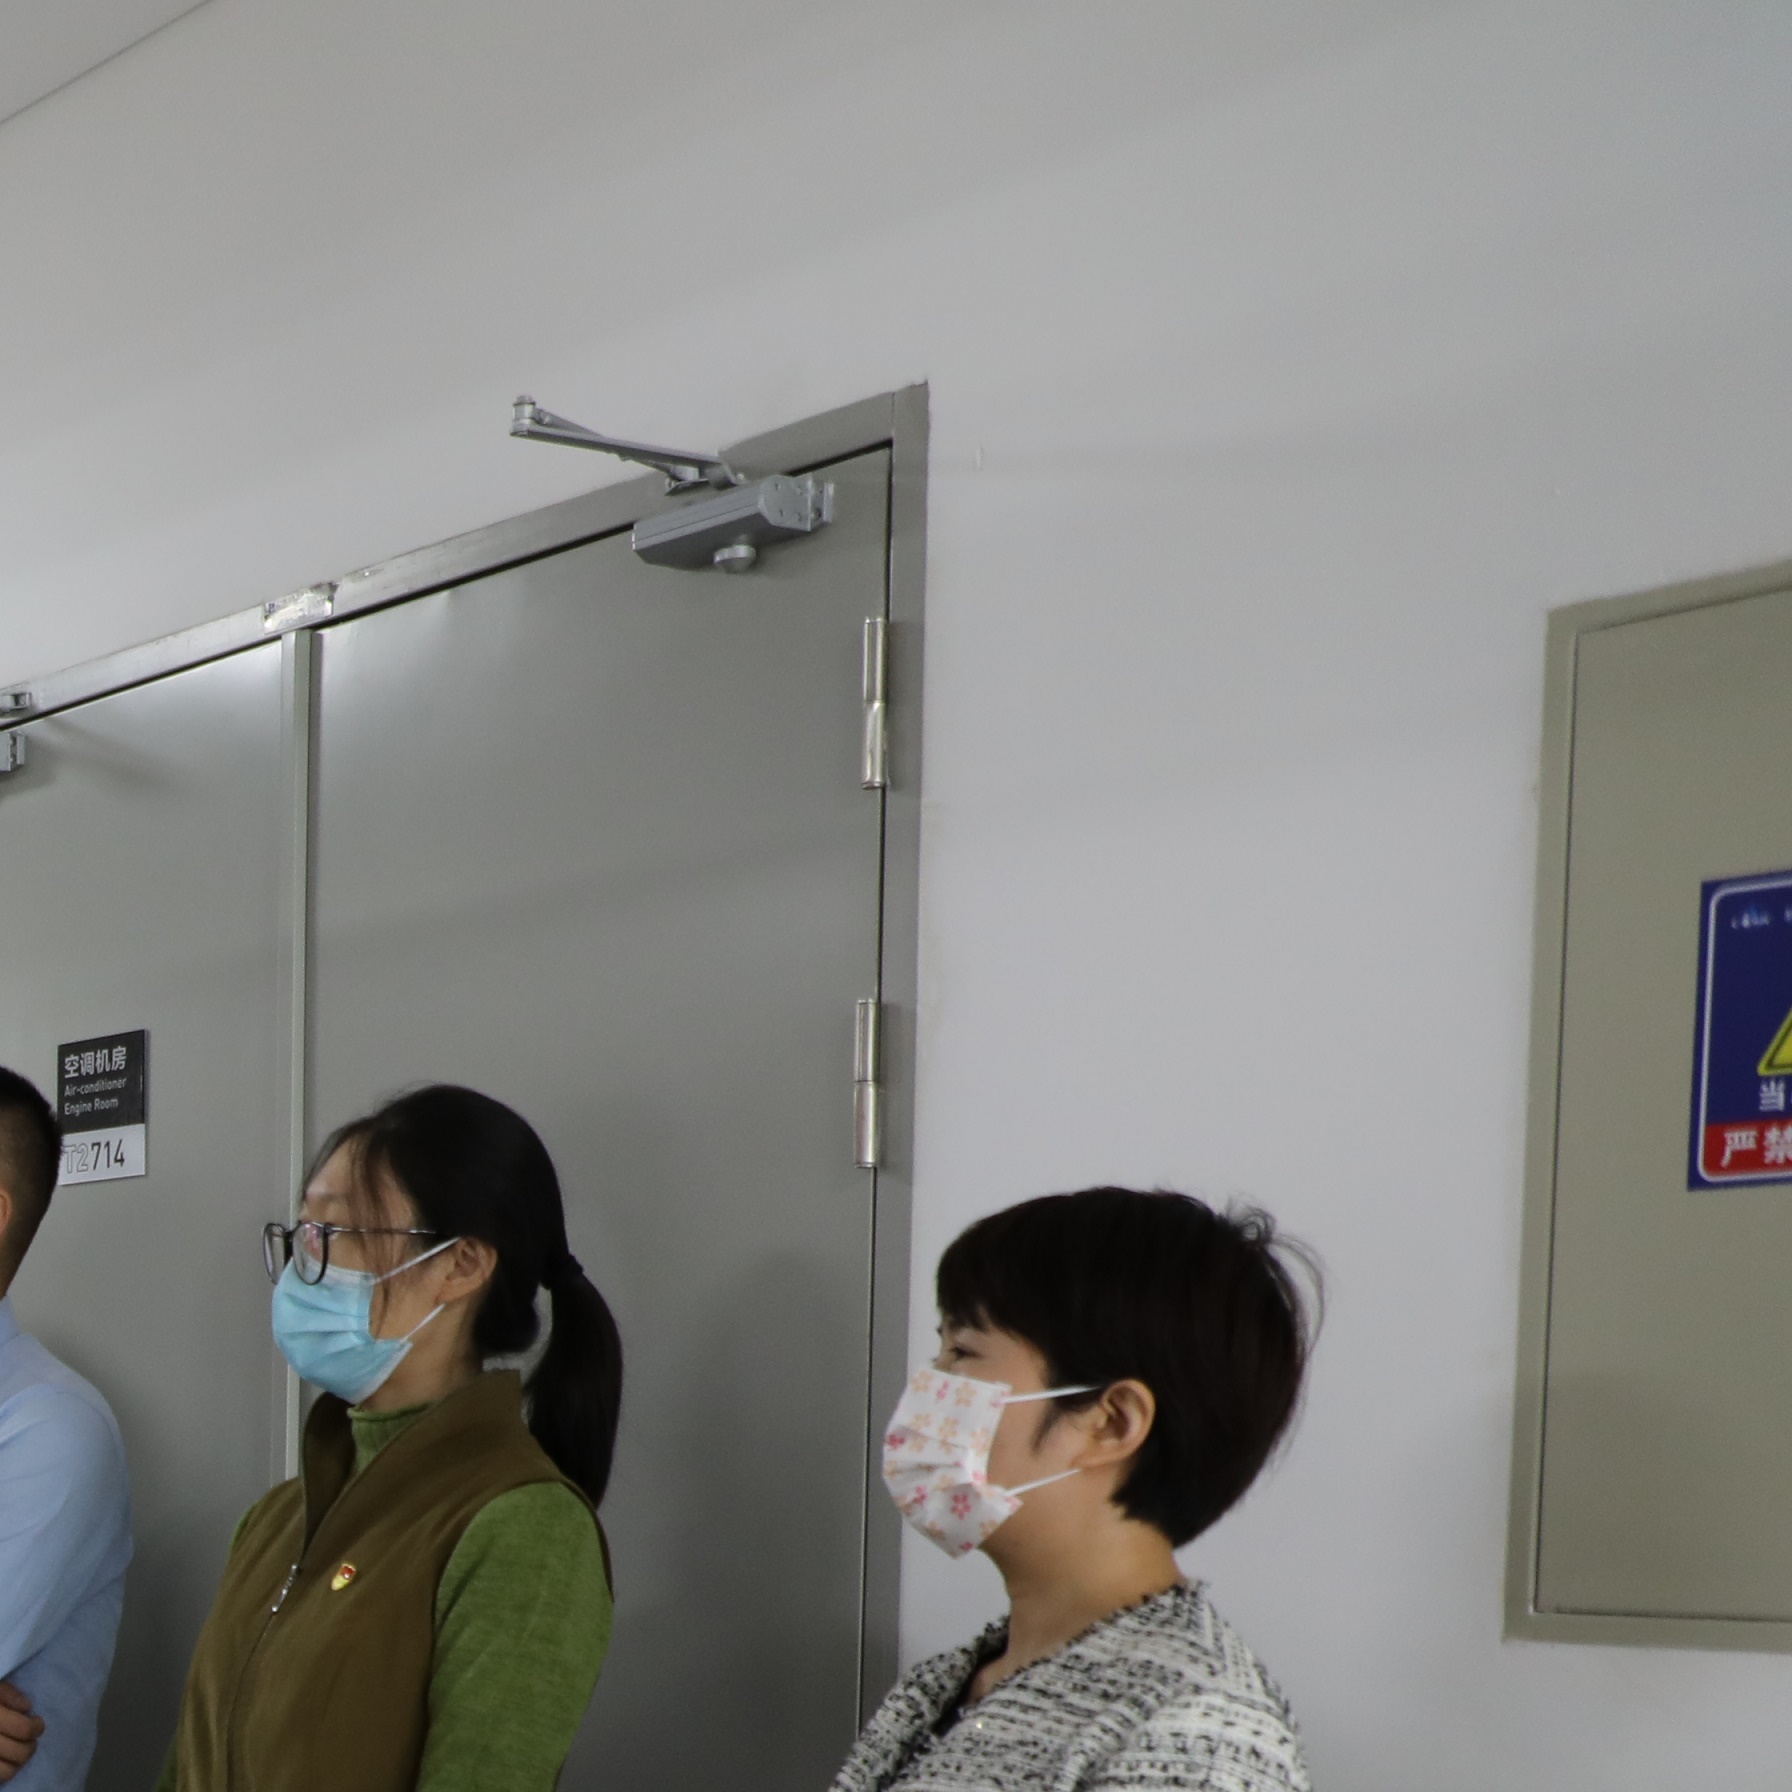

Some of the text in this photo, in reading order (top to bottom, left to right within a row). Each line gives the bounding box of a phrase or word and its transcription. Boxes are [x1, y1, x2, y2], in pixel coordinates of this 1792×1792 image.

[64, 1045, 127, 1079] 空调机房
[64, 1077, 127, 1097] Air-conditioner
[64, 1097, 119, 1117] Engine Room
[64, 1138, 125, 1174] T2714
